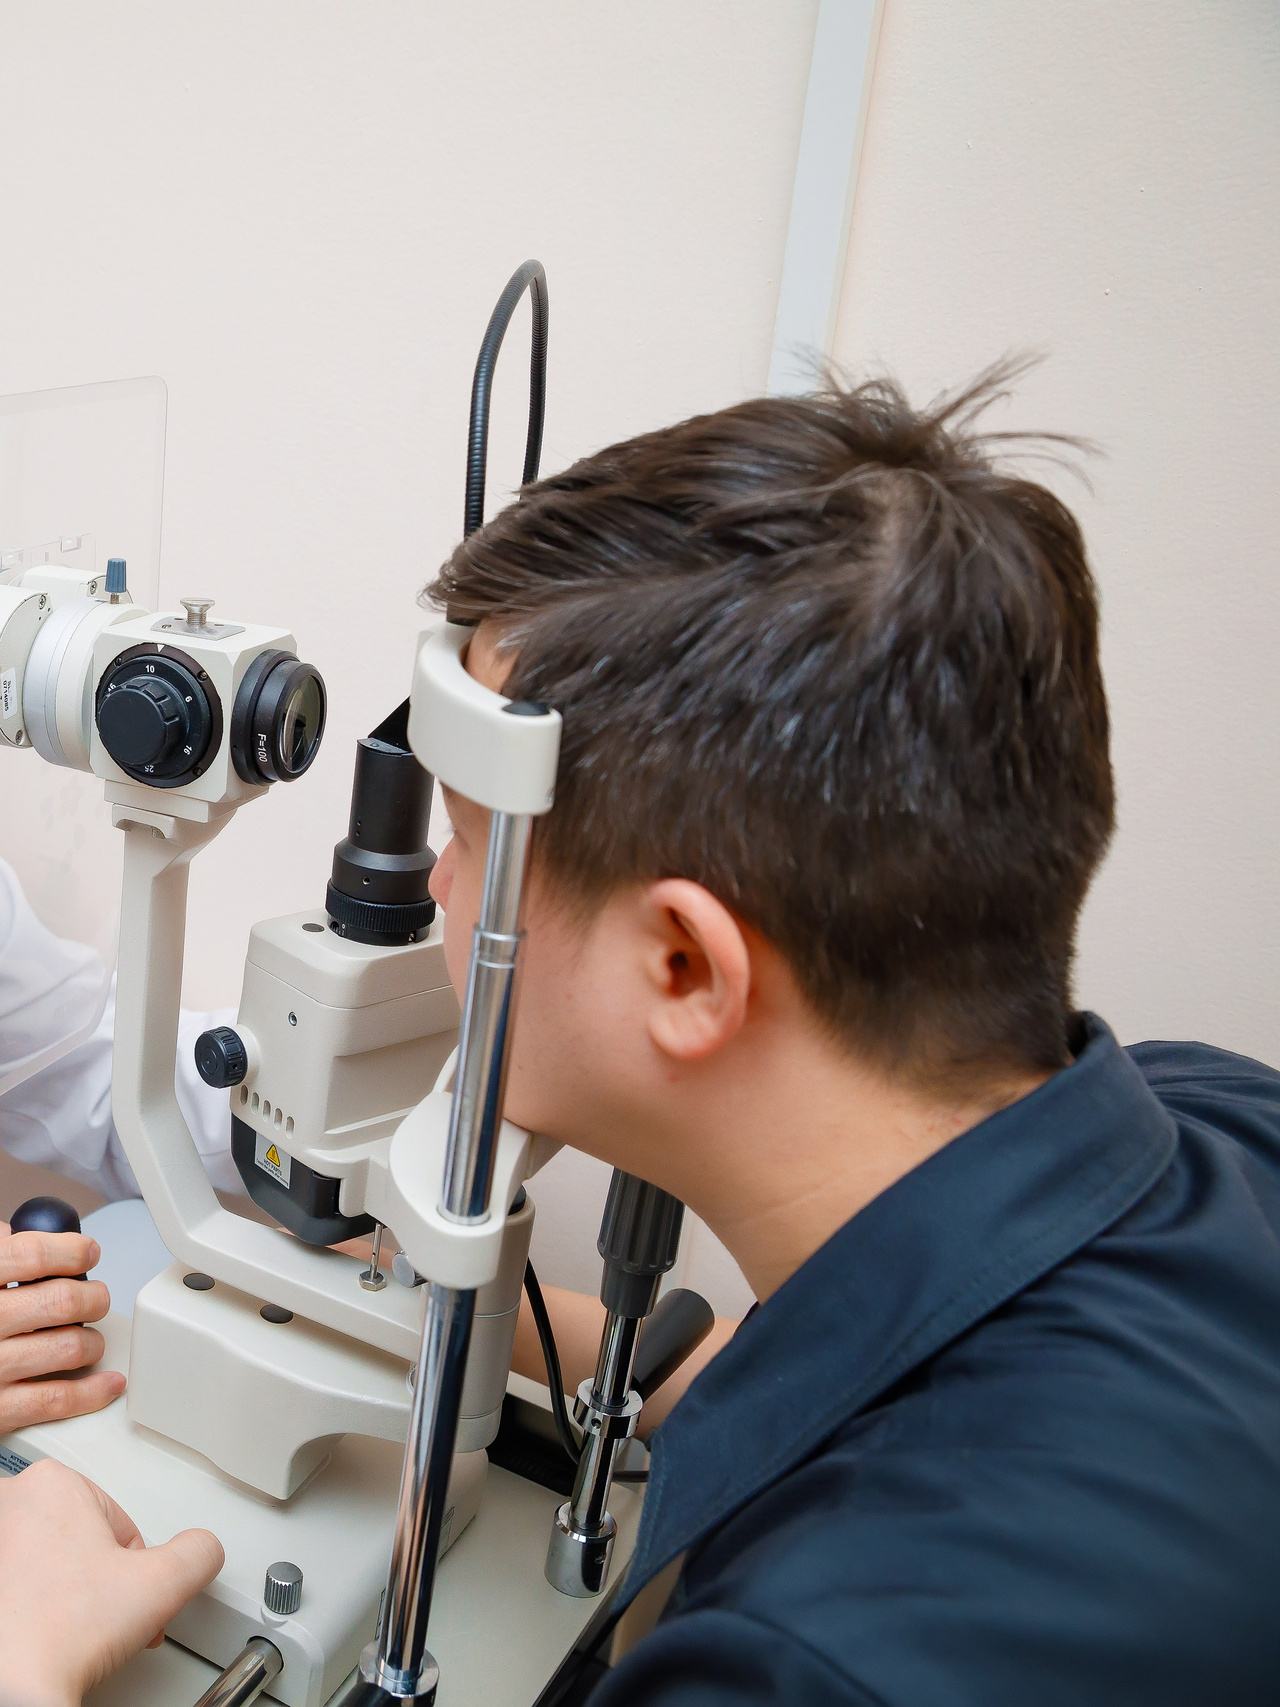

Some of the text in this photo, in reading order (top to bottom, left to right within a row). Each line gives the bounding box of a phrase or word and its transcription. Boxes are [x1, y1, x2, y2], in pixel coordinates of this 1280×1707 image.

[145, 664, 155, 673] 10
[185, 695, 193, 703] 6
[183, 744, 193, 756] 16
[257, 733, 268, 763] F=100
[144, 764, 155, 773] 25
